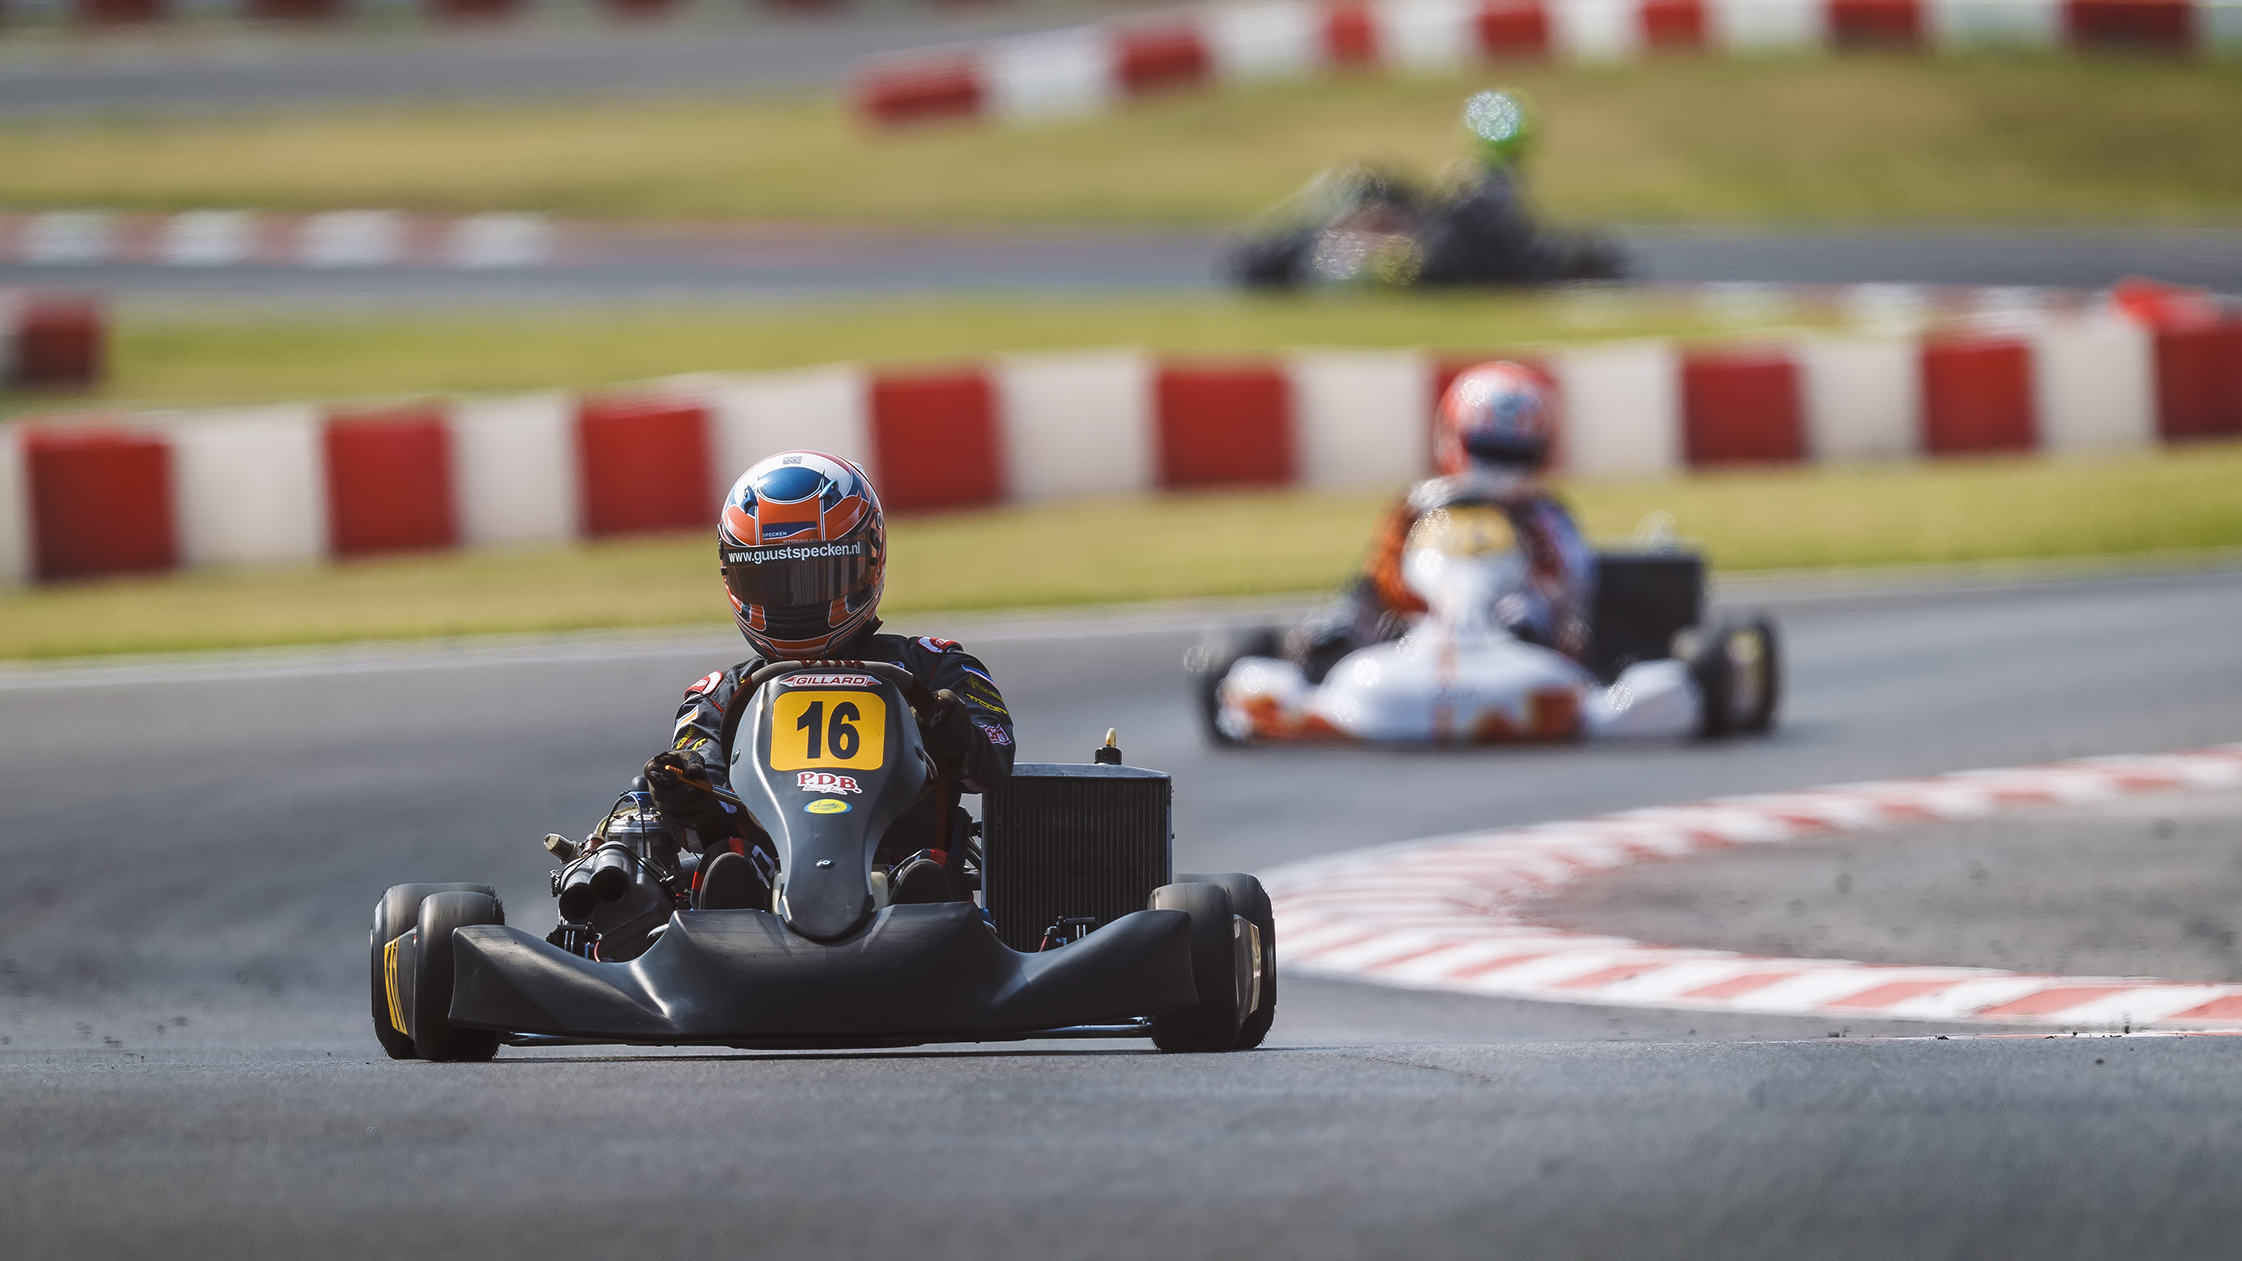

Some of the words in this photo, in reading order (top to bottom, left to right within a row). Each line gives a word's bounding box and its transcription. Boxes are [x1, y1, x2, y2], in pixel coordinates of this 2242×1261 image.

[728, 541, 860, 564] www.guustspecken.nl
[796, 677, 865, 685] GILLARD
[797, 701, 861, 760] 16
